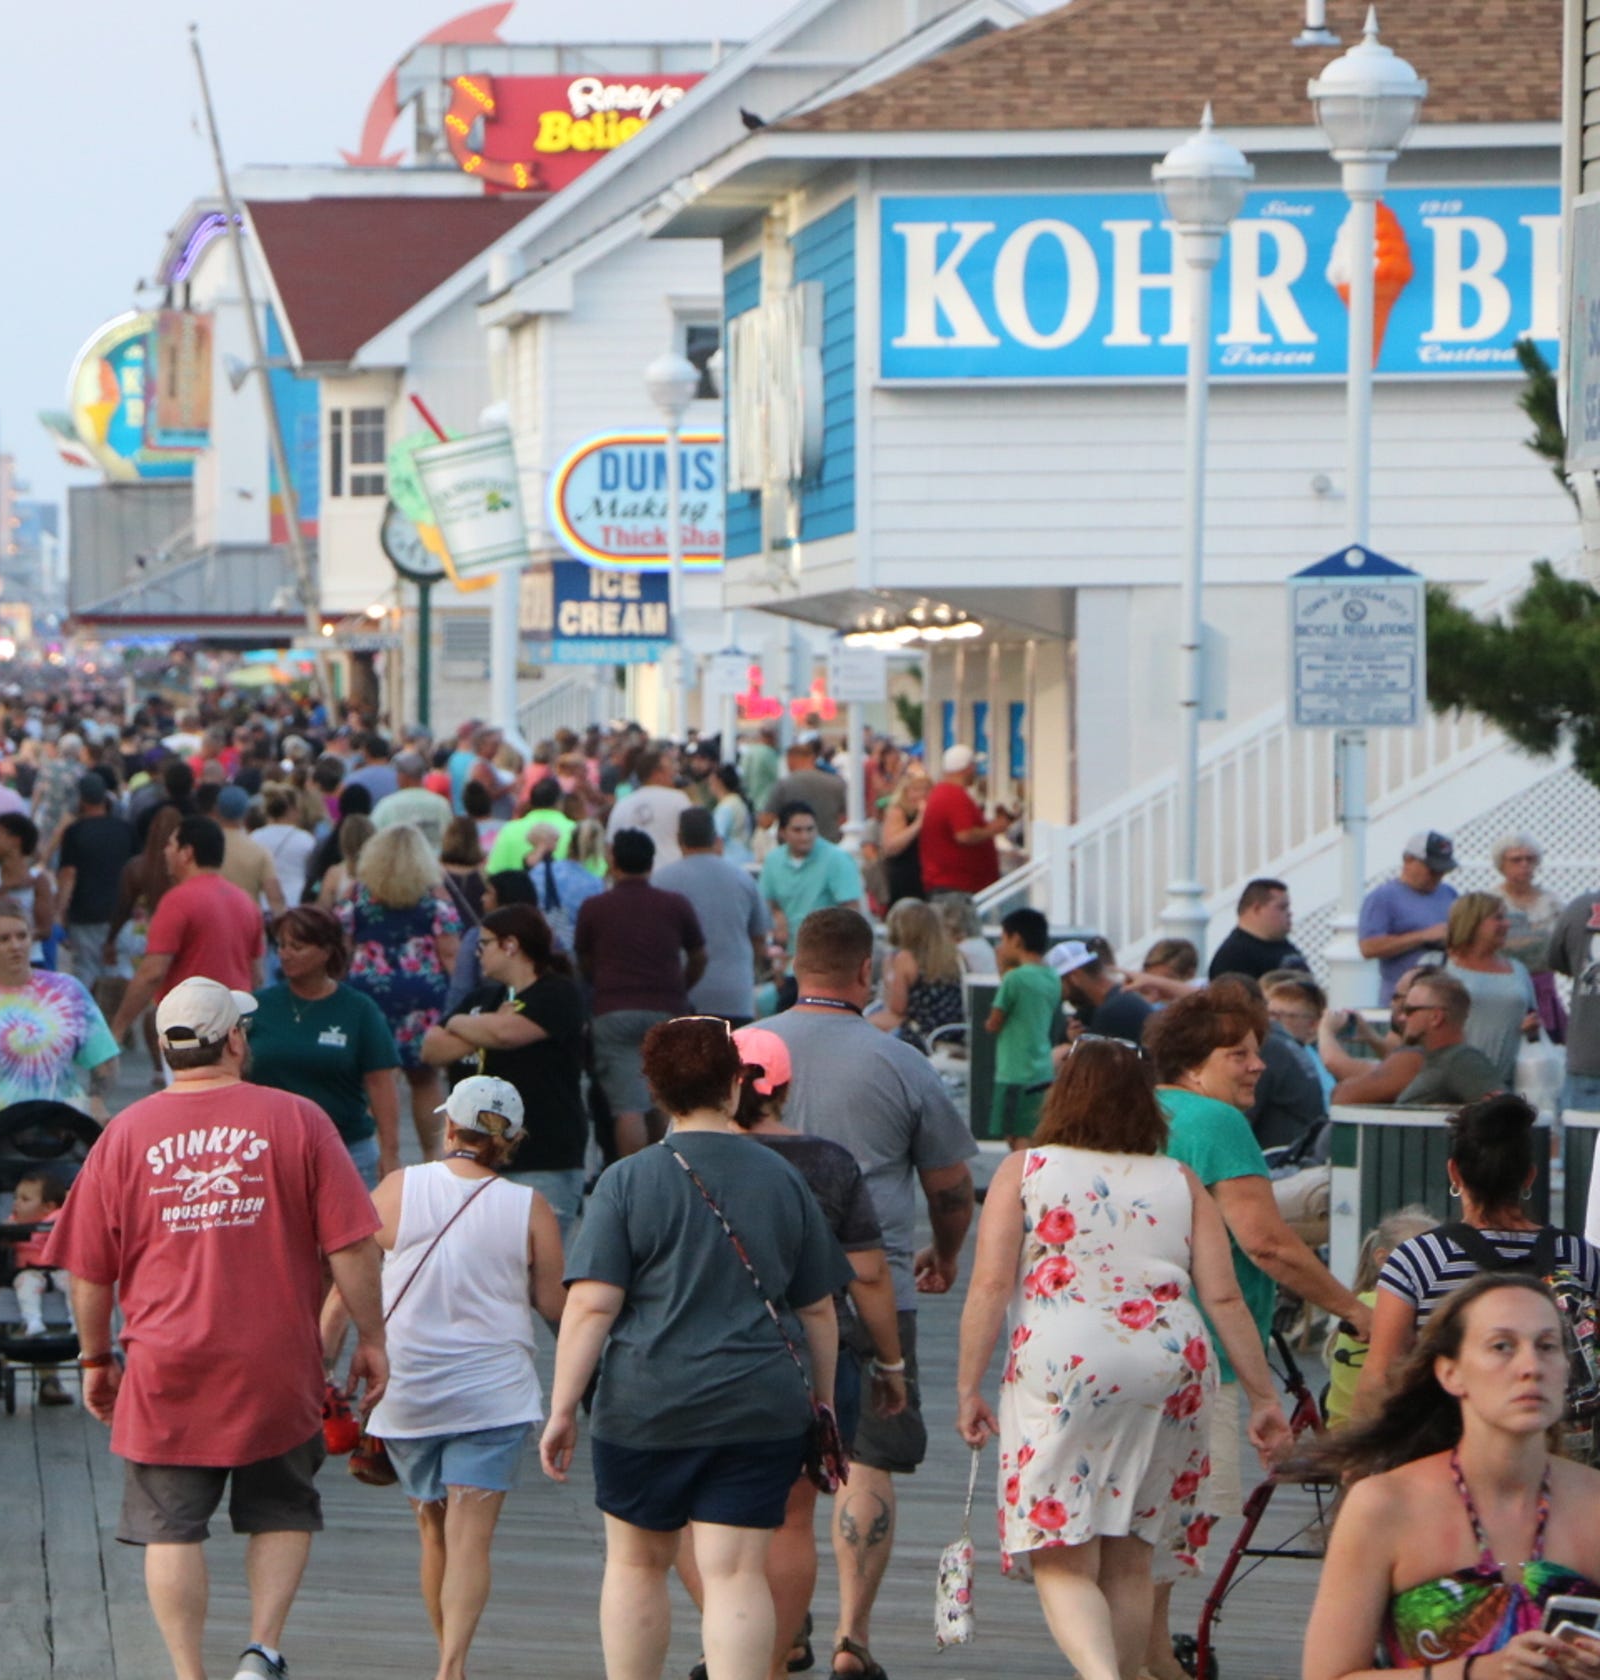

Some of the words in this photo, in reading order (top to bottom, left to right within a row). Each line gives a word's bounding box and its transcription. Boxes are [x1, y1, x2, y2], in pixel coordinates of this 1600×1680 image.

[892, 217, 1318, 350] KOHR
[602, 525, 668, 547] Thick
[589, 567, 642, 599] ICE
[558, 601, 668, 636] CREAM
[146, 1126, 269, 1175] STINKY'S
[230, 1197, 265, 1213] FISH
